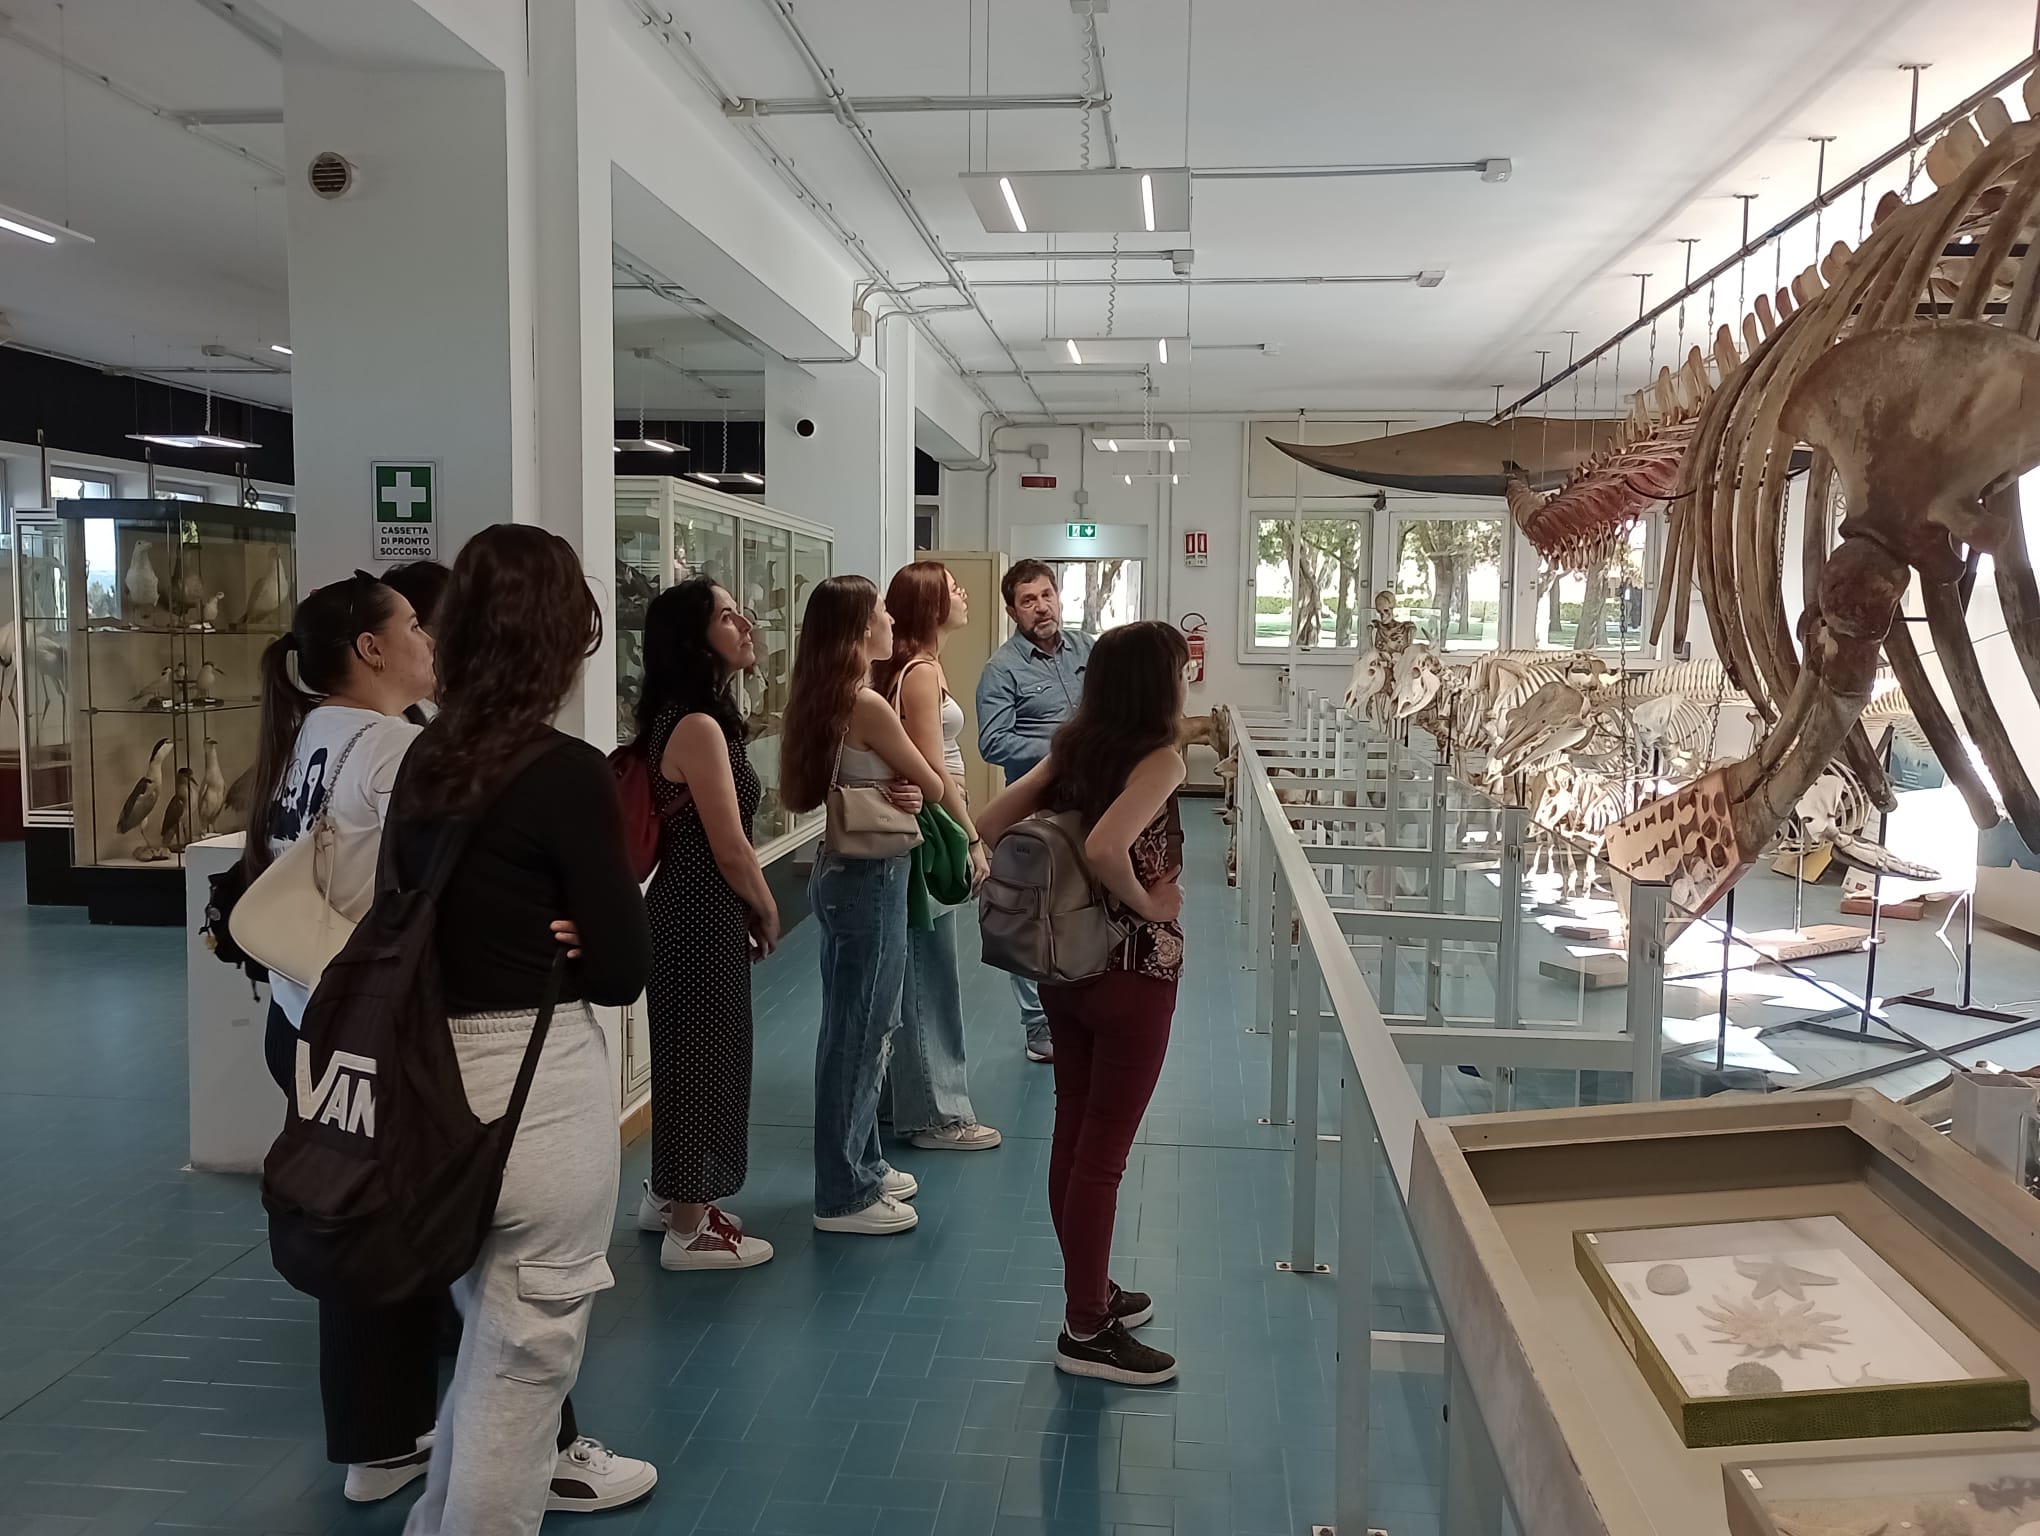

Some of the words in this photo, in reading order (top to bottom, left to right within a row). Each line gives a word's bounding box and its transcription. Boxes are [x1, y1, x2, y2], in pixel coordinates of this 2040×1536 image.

[381, 527, 429, 535] CASSETTA
[381, 537, 390, 545] DI
[392, 537, 430, 545] PRONTO
[380, 548, 431, 556] SOCCORSO
